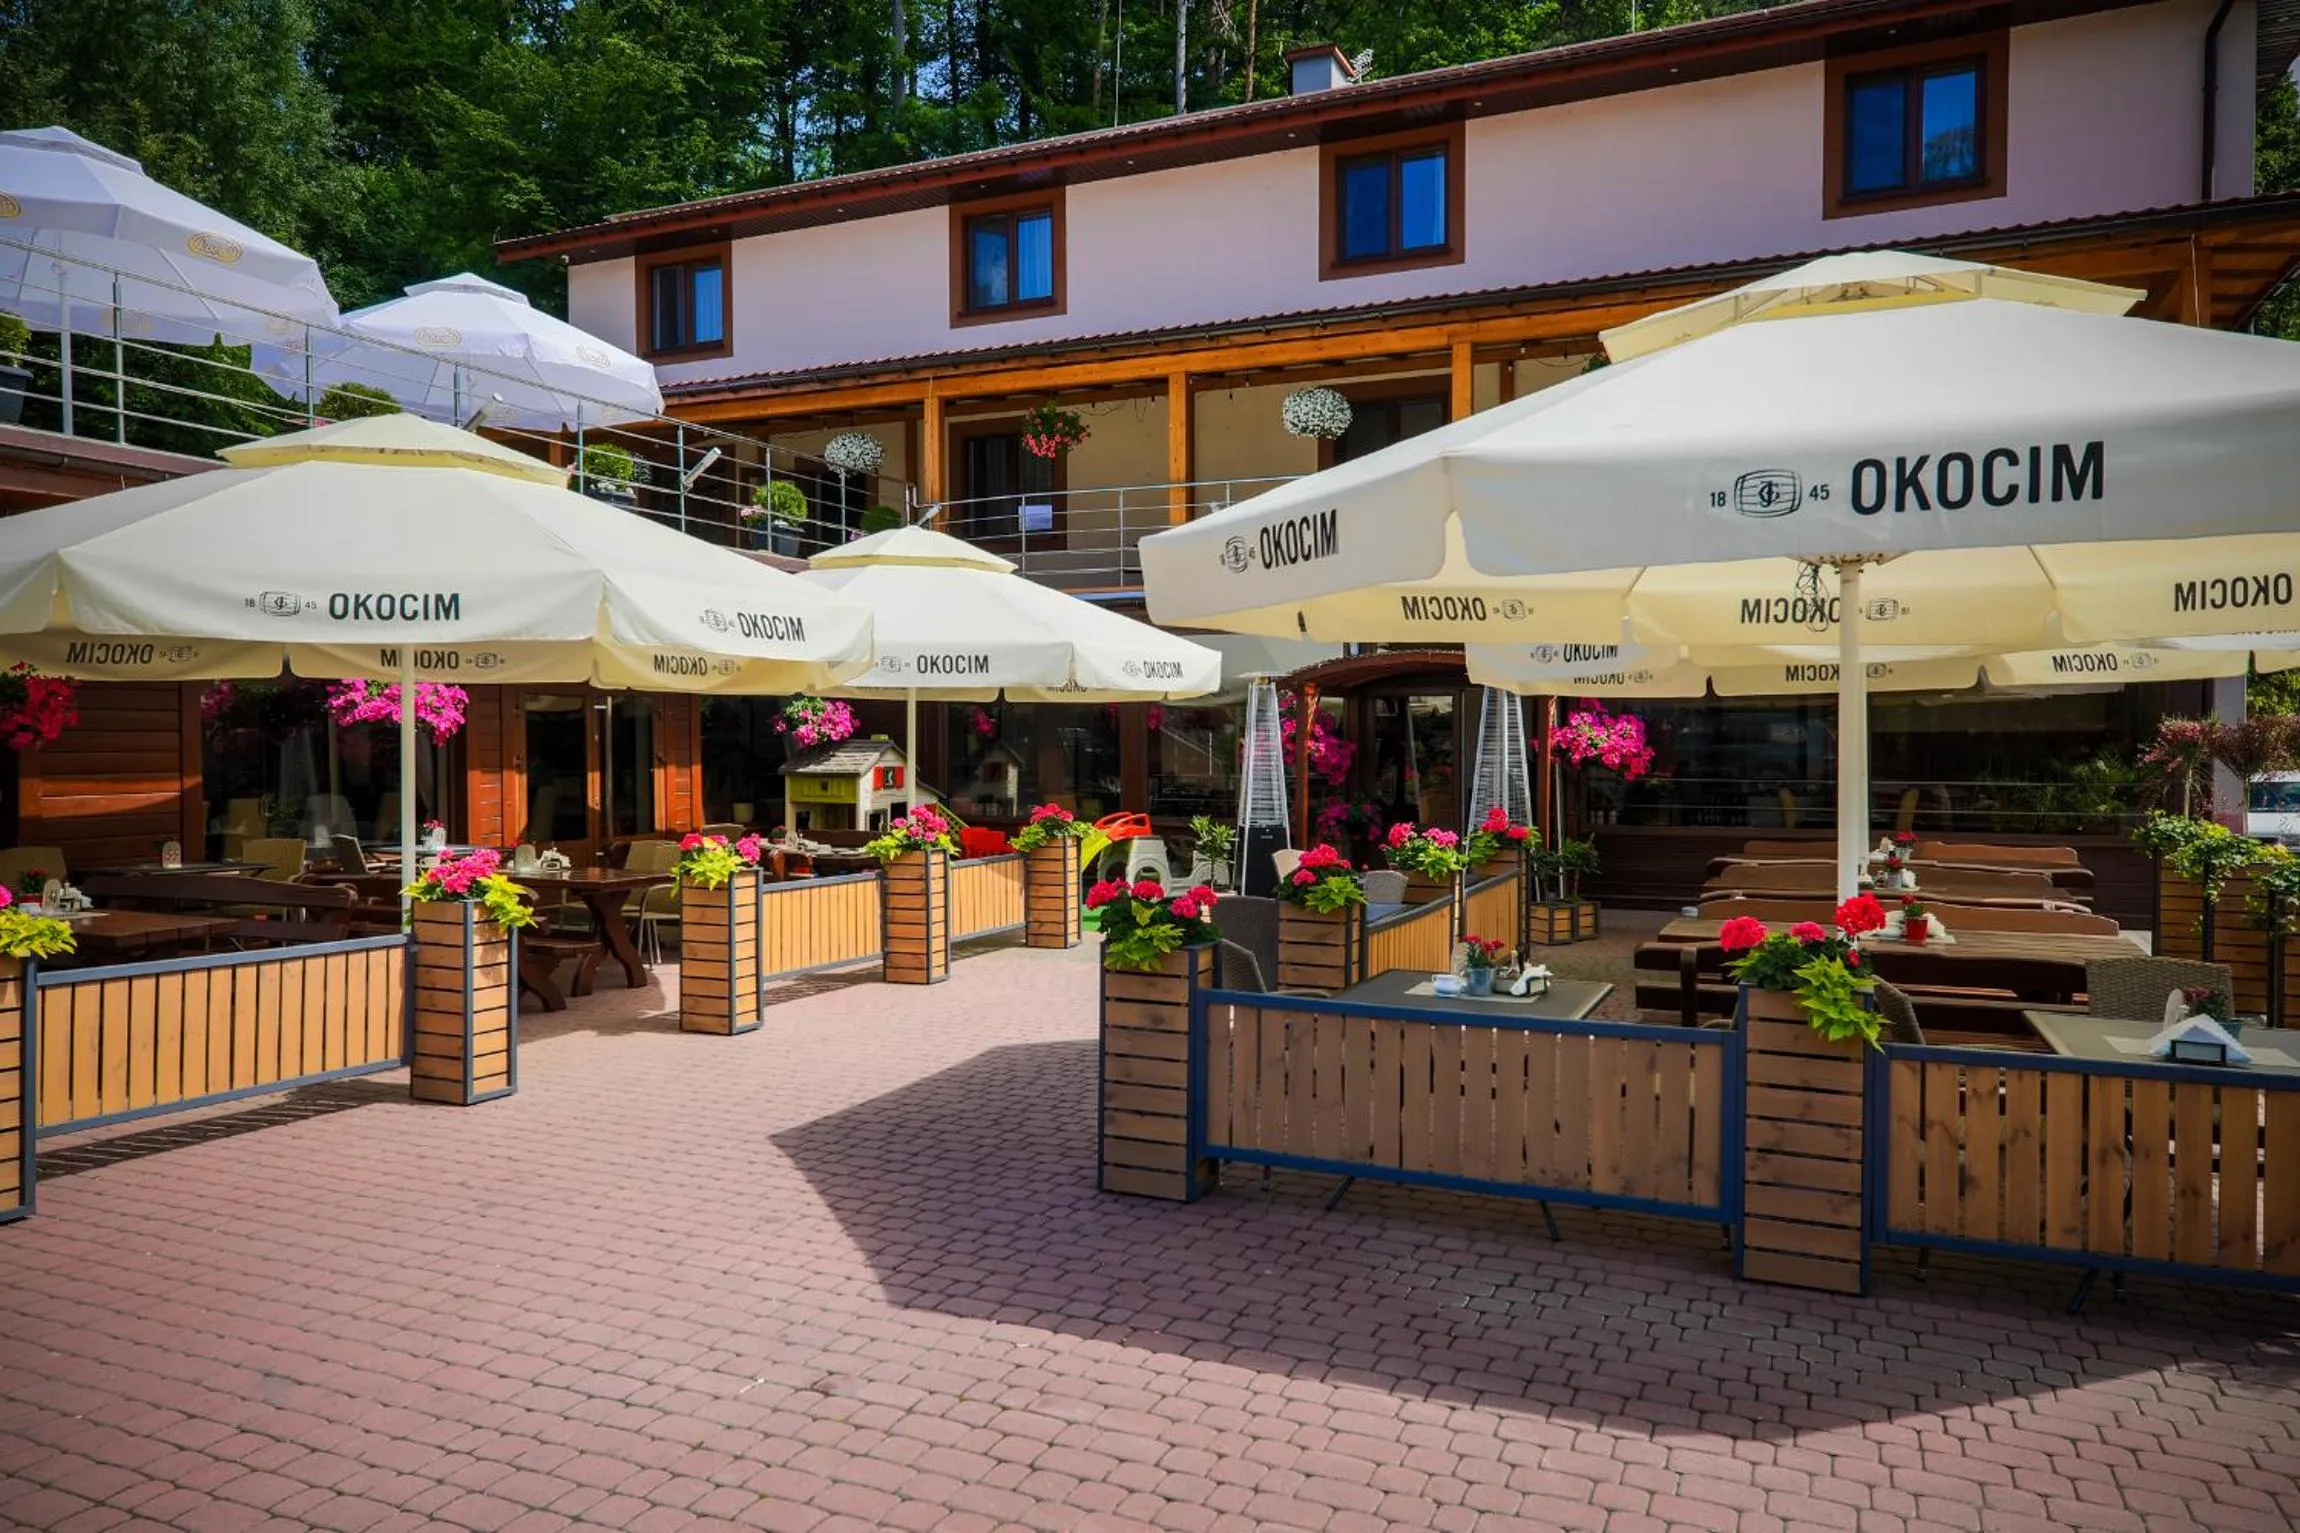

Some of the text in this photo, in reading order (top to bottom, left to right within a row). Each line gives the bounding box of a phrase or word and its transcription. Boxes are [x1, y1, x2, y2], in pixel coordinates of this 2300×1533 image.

[1710, 441, 2104, 515] 18 45 OKOCIM
[1259, 509, 1340, 570] OKOCIM
[304, 601, 317, 610] 45
[328, 593, 460, 621] OKOCIM
[737, 612, 805, 642] OKOCIM
[917, 655, 990, 674] OKOCIM
[1144, 661, 1184, 678] OKOCIM
